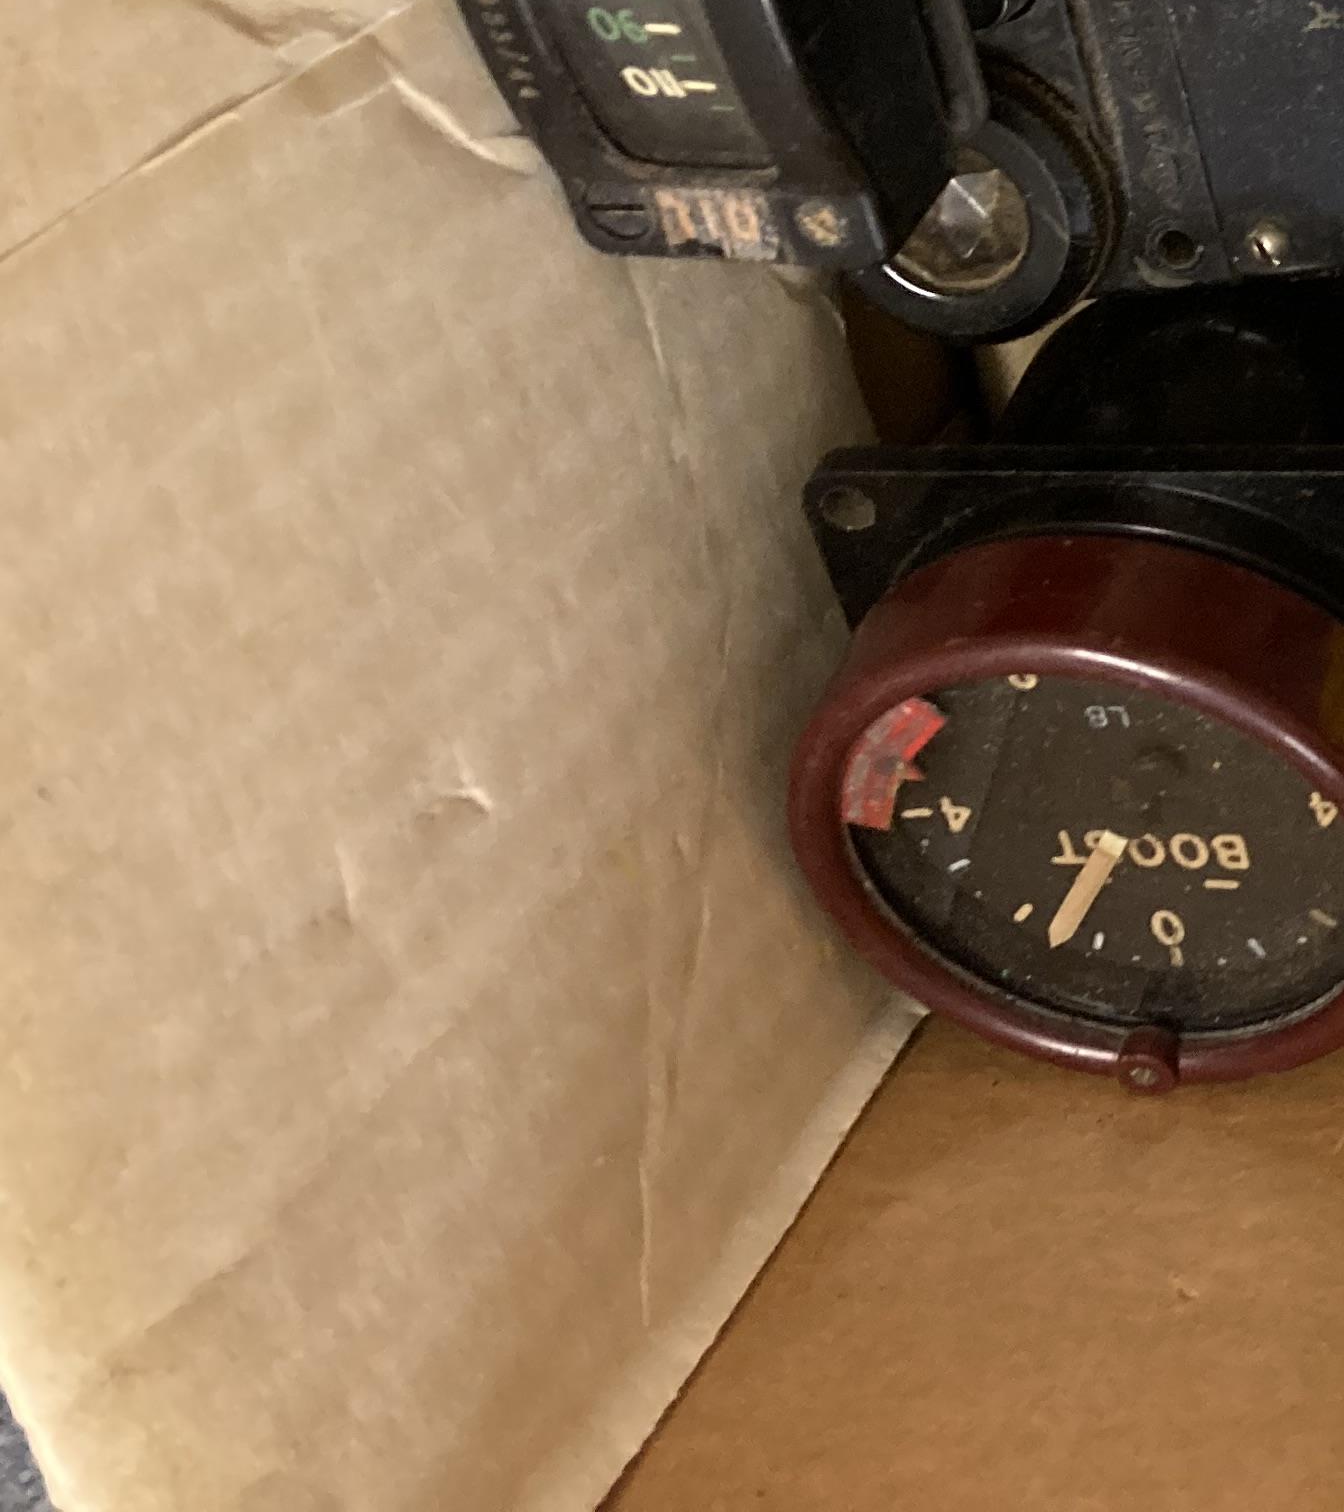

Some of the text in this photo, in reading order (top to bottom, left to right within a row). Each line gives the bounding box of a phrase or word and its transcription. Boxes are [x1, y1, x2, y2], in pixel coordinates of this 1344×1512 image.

[940, 796, 971, 833] 4
[1051, 831, 1250, 871] BOOT
[1151, 909, 1186, 946] 0
